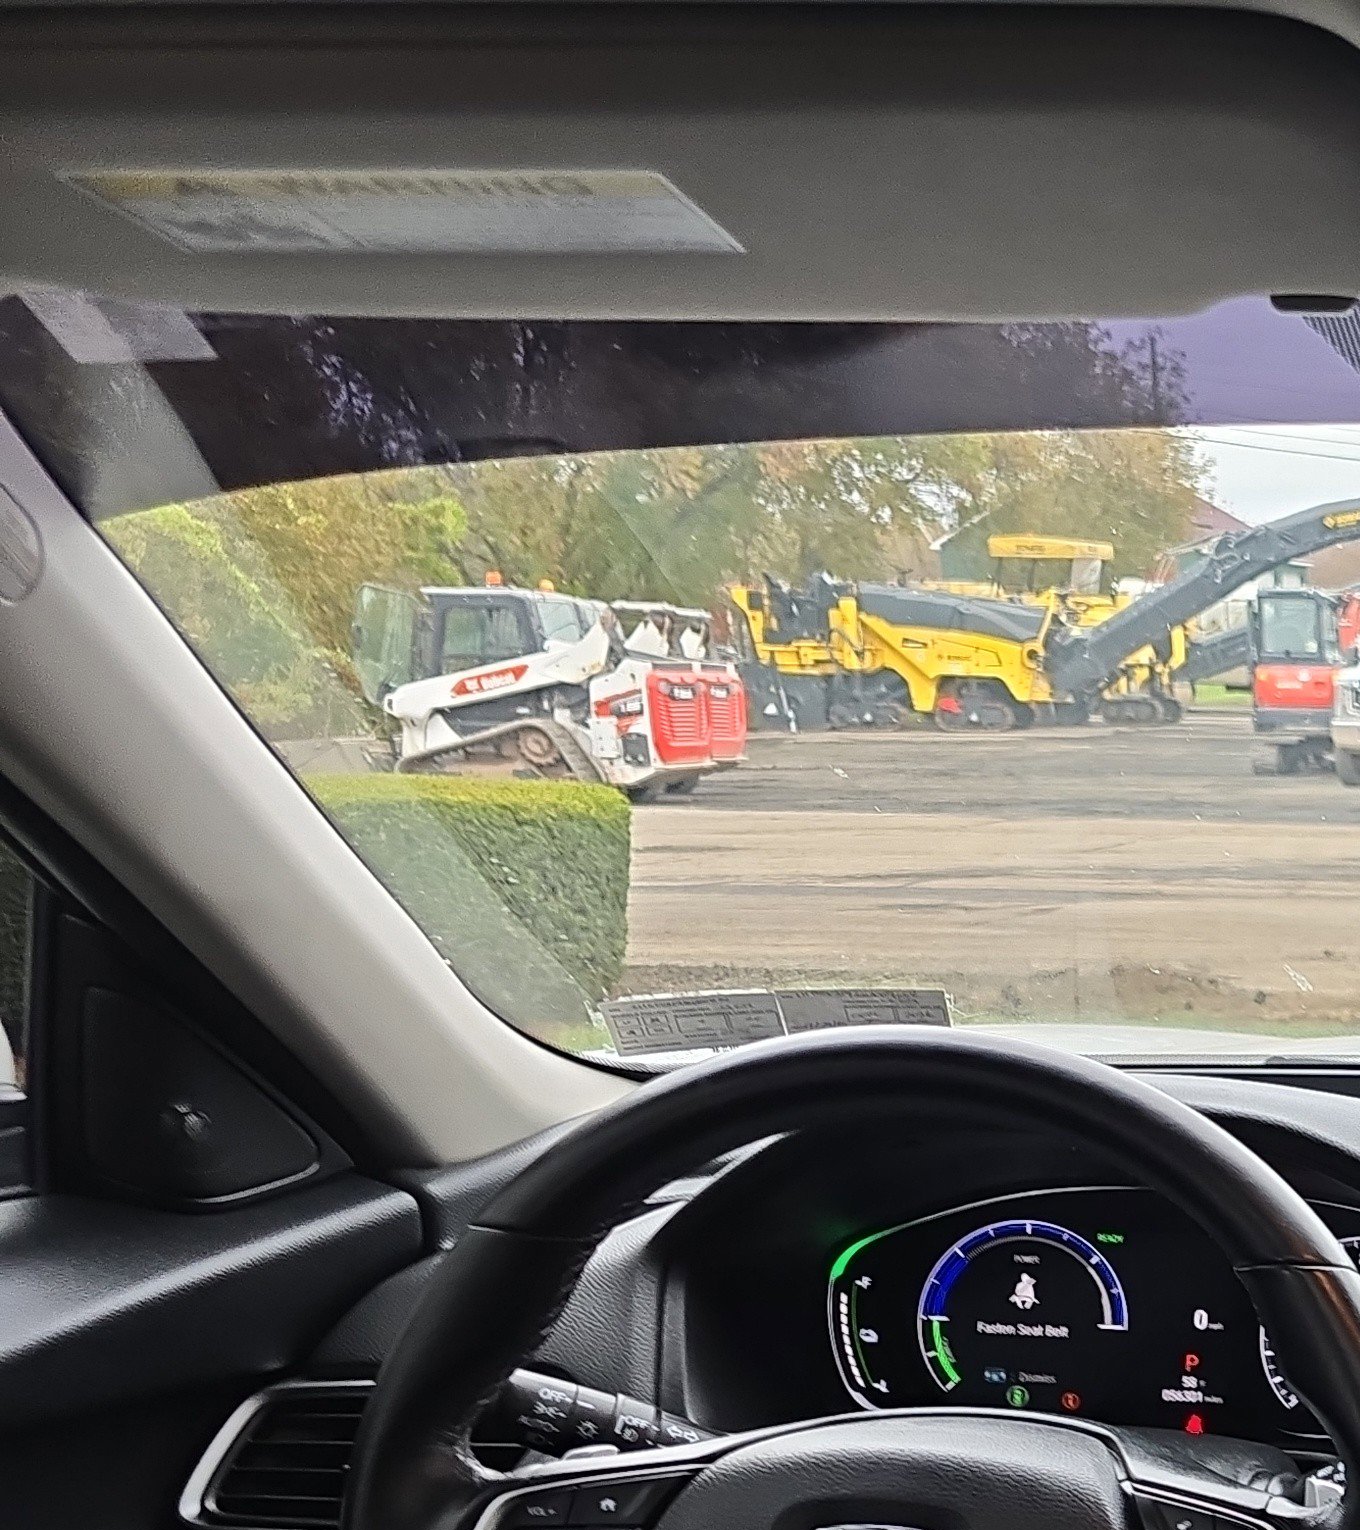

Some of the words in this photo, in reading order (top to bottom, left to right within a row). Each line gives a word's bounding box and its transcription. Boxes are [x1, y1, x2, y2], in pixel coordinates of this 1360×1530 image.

[1193, 1309, 1209, 1330] 0
[976, 1320, 1016, 1335] Fasten
[1016, 1323, 1044, 1337] Seat
[1045, 1324, 1069, 1338] Belt
[1185, 1354, 1200, 1372] P
